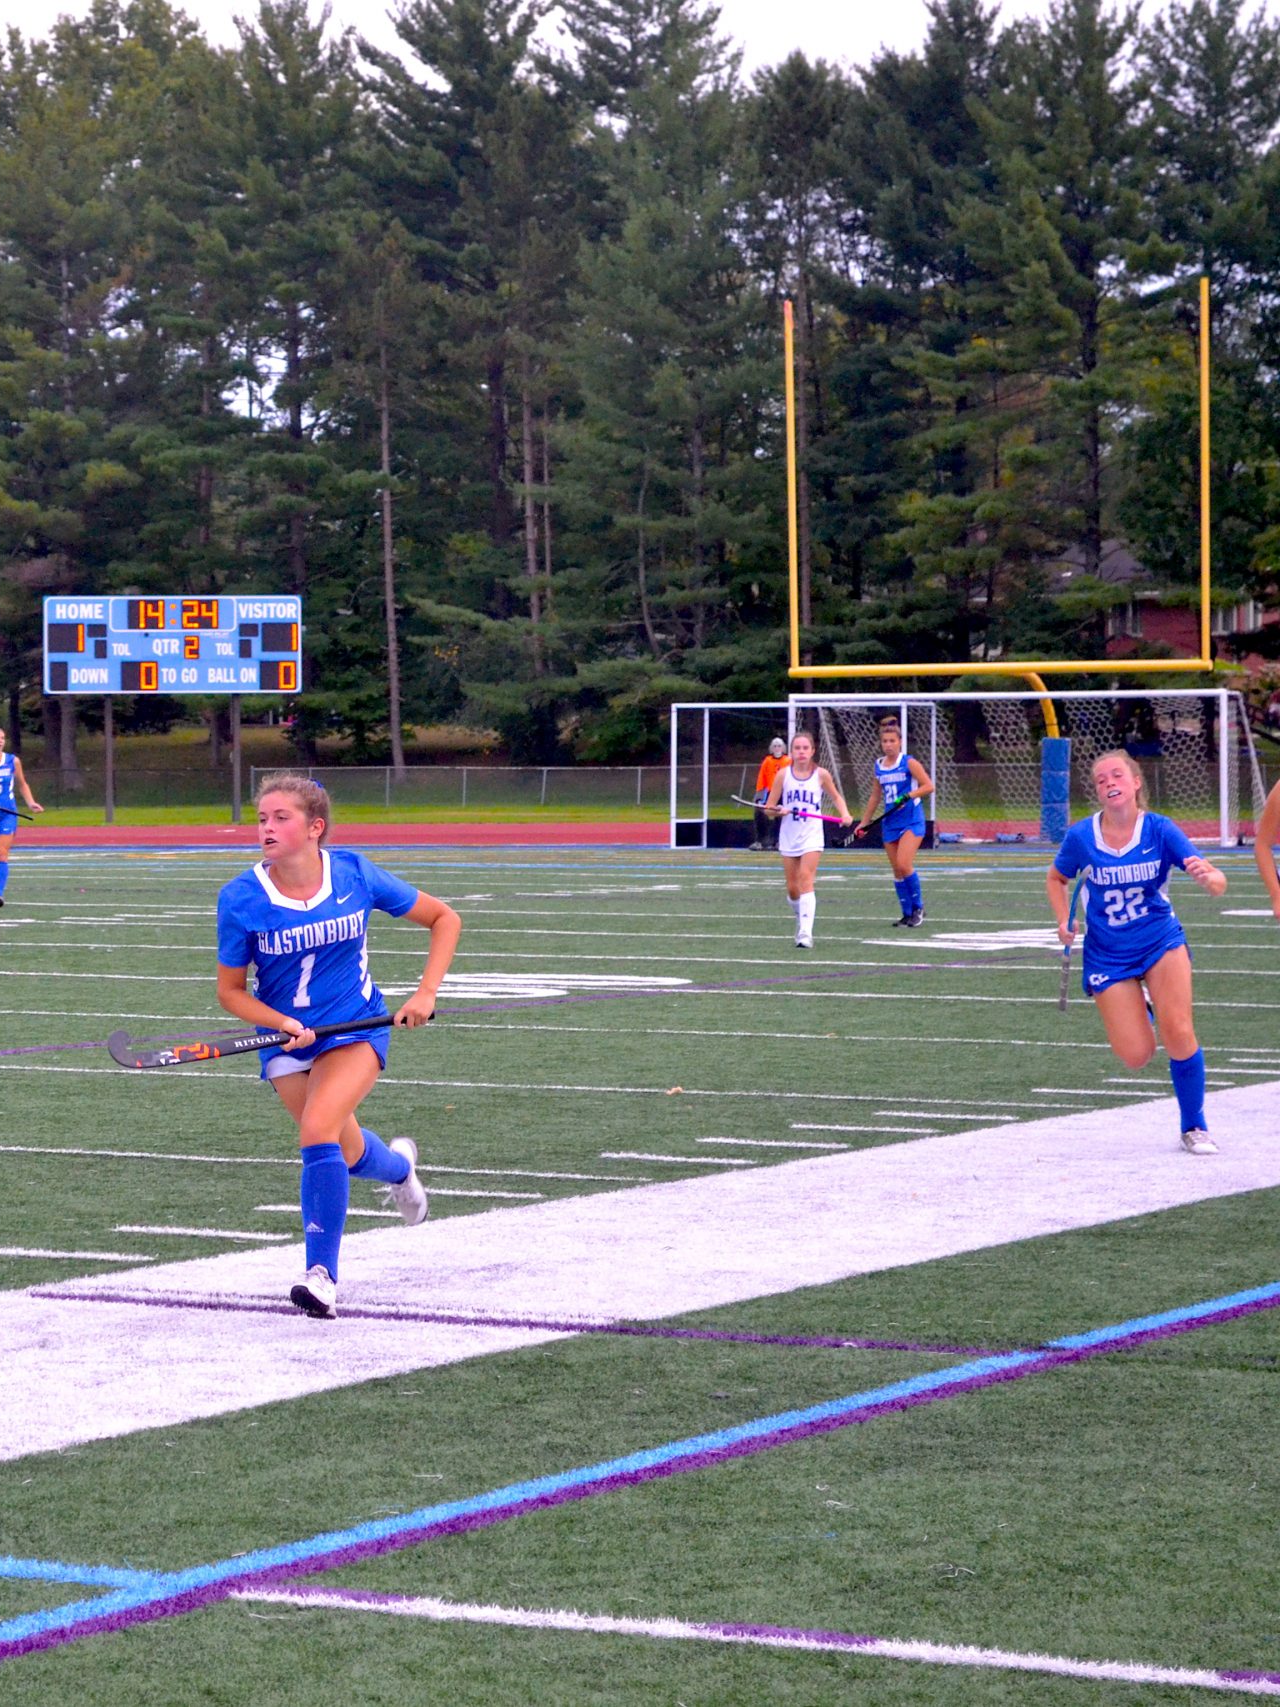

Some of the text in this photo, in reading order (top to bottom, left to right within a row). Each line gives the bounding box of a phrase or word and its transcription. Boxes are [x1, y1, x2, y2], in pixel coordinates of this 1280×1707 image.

[56, 603, 104, 619] HOME
[140, 600, 218, 629] 14:24
[239, 603, 297, 618] VISITOR
[77, 624, 84, 653] 1
[291, 623, 298, 651] 1
[112, 643, 131, 656] TOL
[152, 638, 180, 656] QTR
[184, 636, 199, 659] 2
[215, 643, 234, 655] TOL
[71, 668, 109, 684] DOWN
[140, 661, 158, 690] 0
[161, 668, 198, 684] TO GO
[207, 668, 257, 683] BALL ON
[278, 661, 296, 690] 0
[786, 790, 816, 805] HALL
[884, 784, 898, 804] 21
[1104, 887, 1149, 926] 22
[257, 909, 365, 956] GLASTONBURY
[293, 953, 316, 1008] 1
[234, 1034, 280, 1049] RITUAL
